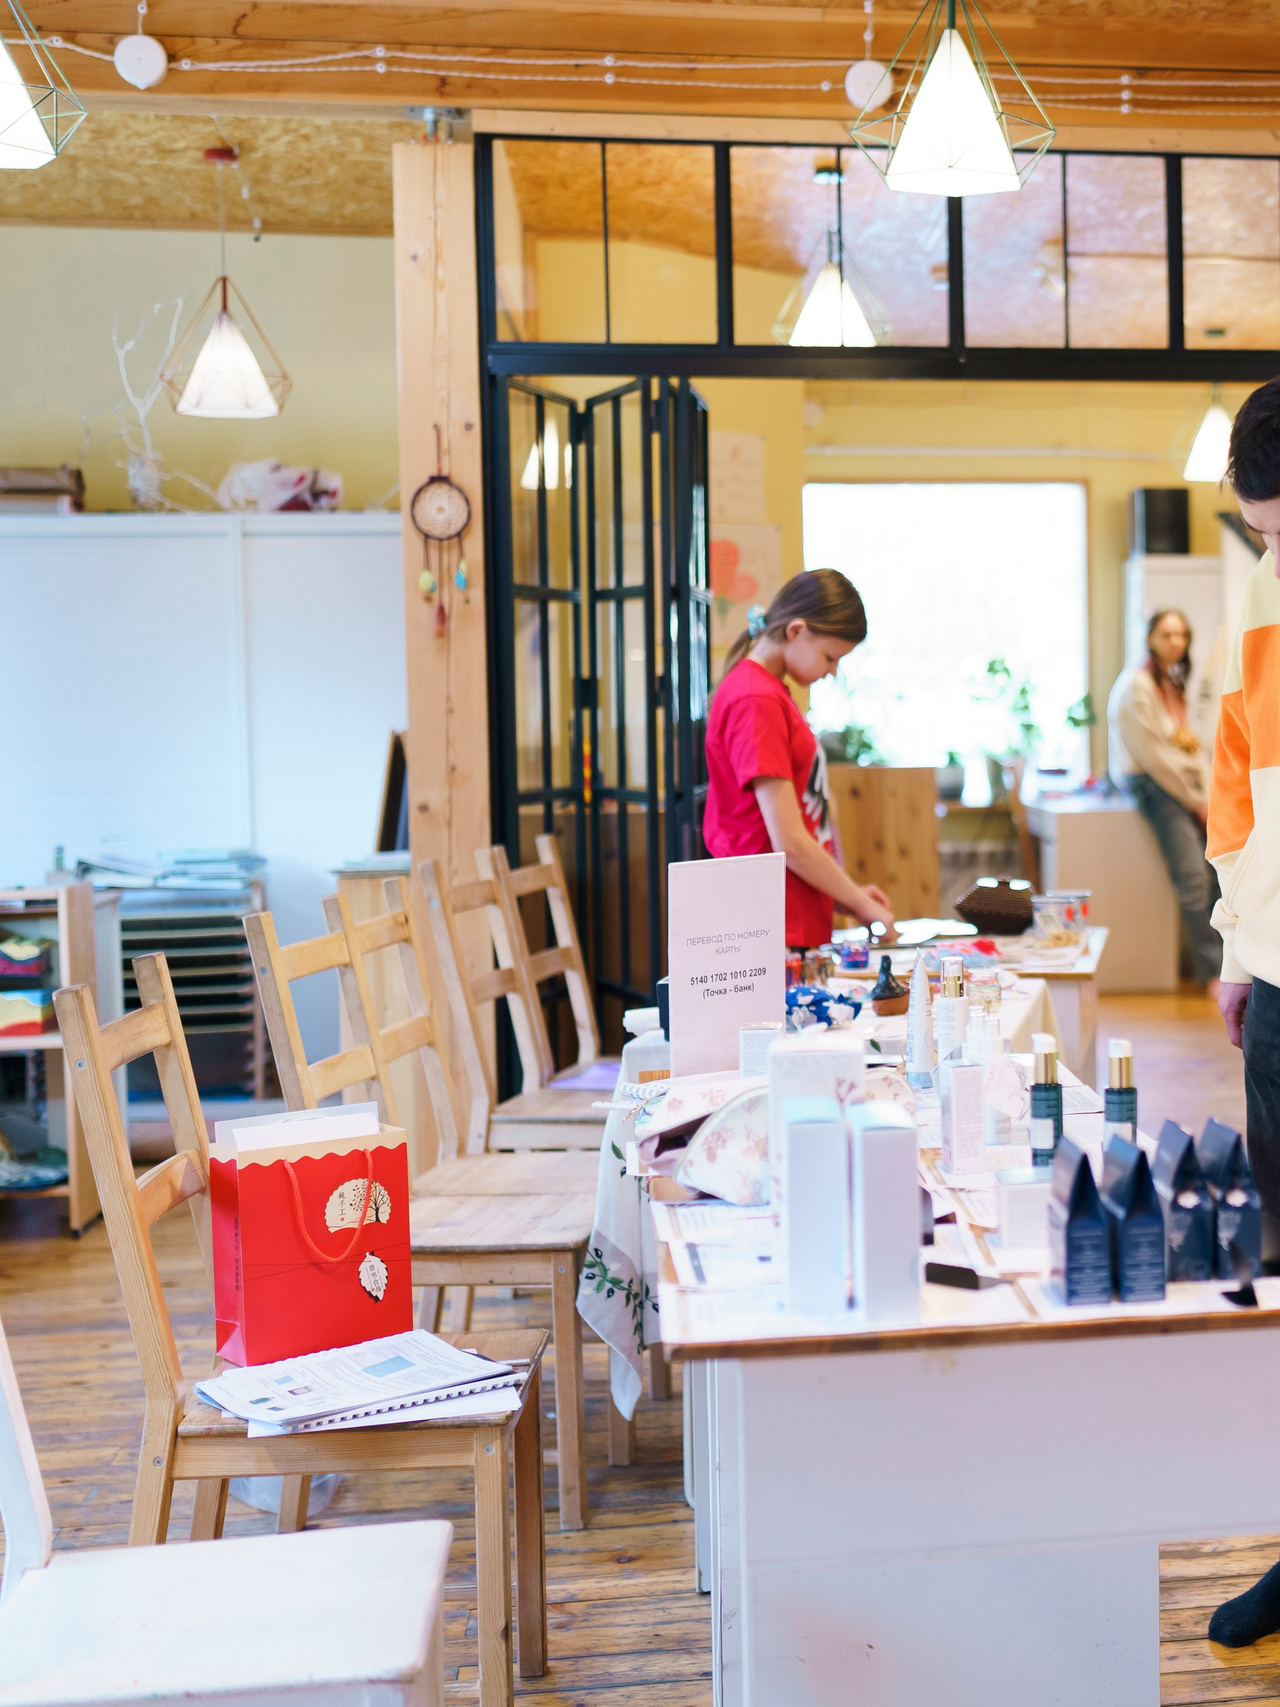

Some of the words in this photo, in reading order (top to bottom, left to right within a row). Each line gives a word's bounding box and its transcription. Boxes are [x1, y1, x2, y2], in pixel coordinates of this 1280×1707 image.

[686, 935, 723, 946] ПЕРЕВОД
[725, 933, 736, 941] ПО
[738, 930, 770, 939] НОМЕРУ
[715, 946, 741, 955] КАРТЫ
[690, 975, 708, 985] 5140
[711, 972, 728, 982] 1702
[730, 970, 747, 979] 1010
[749, 967, 767, 977] 2209
[703, 988, 727, 999] (Точка
[734, 982, 755, 993] банк)
